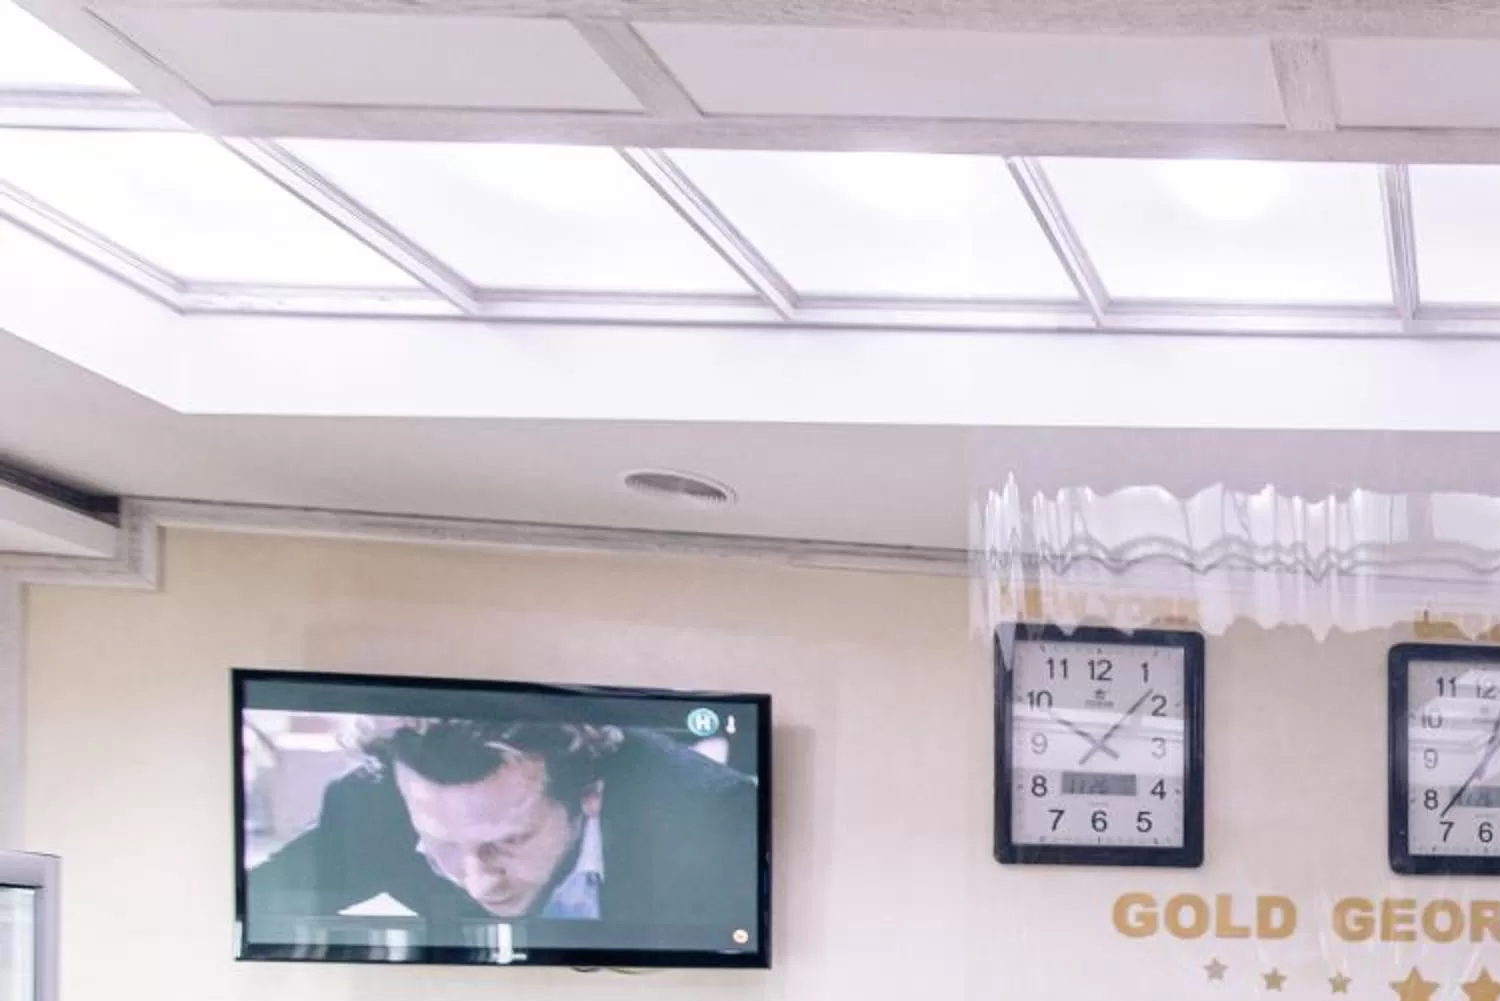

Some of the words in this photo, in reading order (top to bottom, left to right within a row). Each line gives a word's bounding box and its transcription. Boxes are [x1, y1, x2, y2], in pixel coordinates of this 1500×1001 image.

[1046, 657, 1068, 680] 11
[1087, 658, 1113, 682] 12
[1140, 661, 1149, 683] 1
[1436, 677, 1457, 698] 11
[1151, 695, 1168, 717] 2
[1031, 732, 1048, 755] 9
[1151, 737, 1167, 760] 3
[1423, 748, 1439, 769] 9
[1031, 775, 1048, 797] 8
[1150, 779, 1167, 801] 4
[1423, 789, 1439, 811] 8
[1048, 809, 1065, 832] 7
[1091, 810, 1108, 833] 6
[1136, 811, 1153, 833] 5
[1439, 821, 1455, 843] 7
[1478, 822, 1493, 844] 6
[1112, 893, 1297, 939] GOLD
